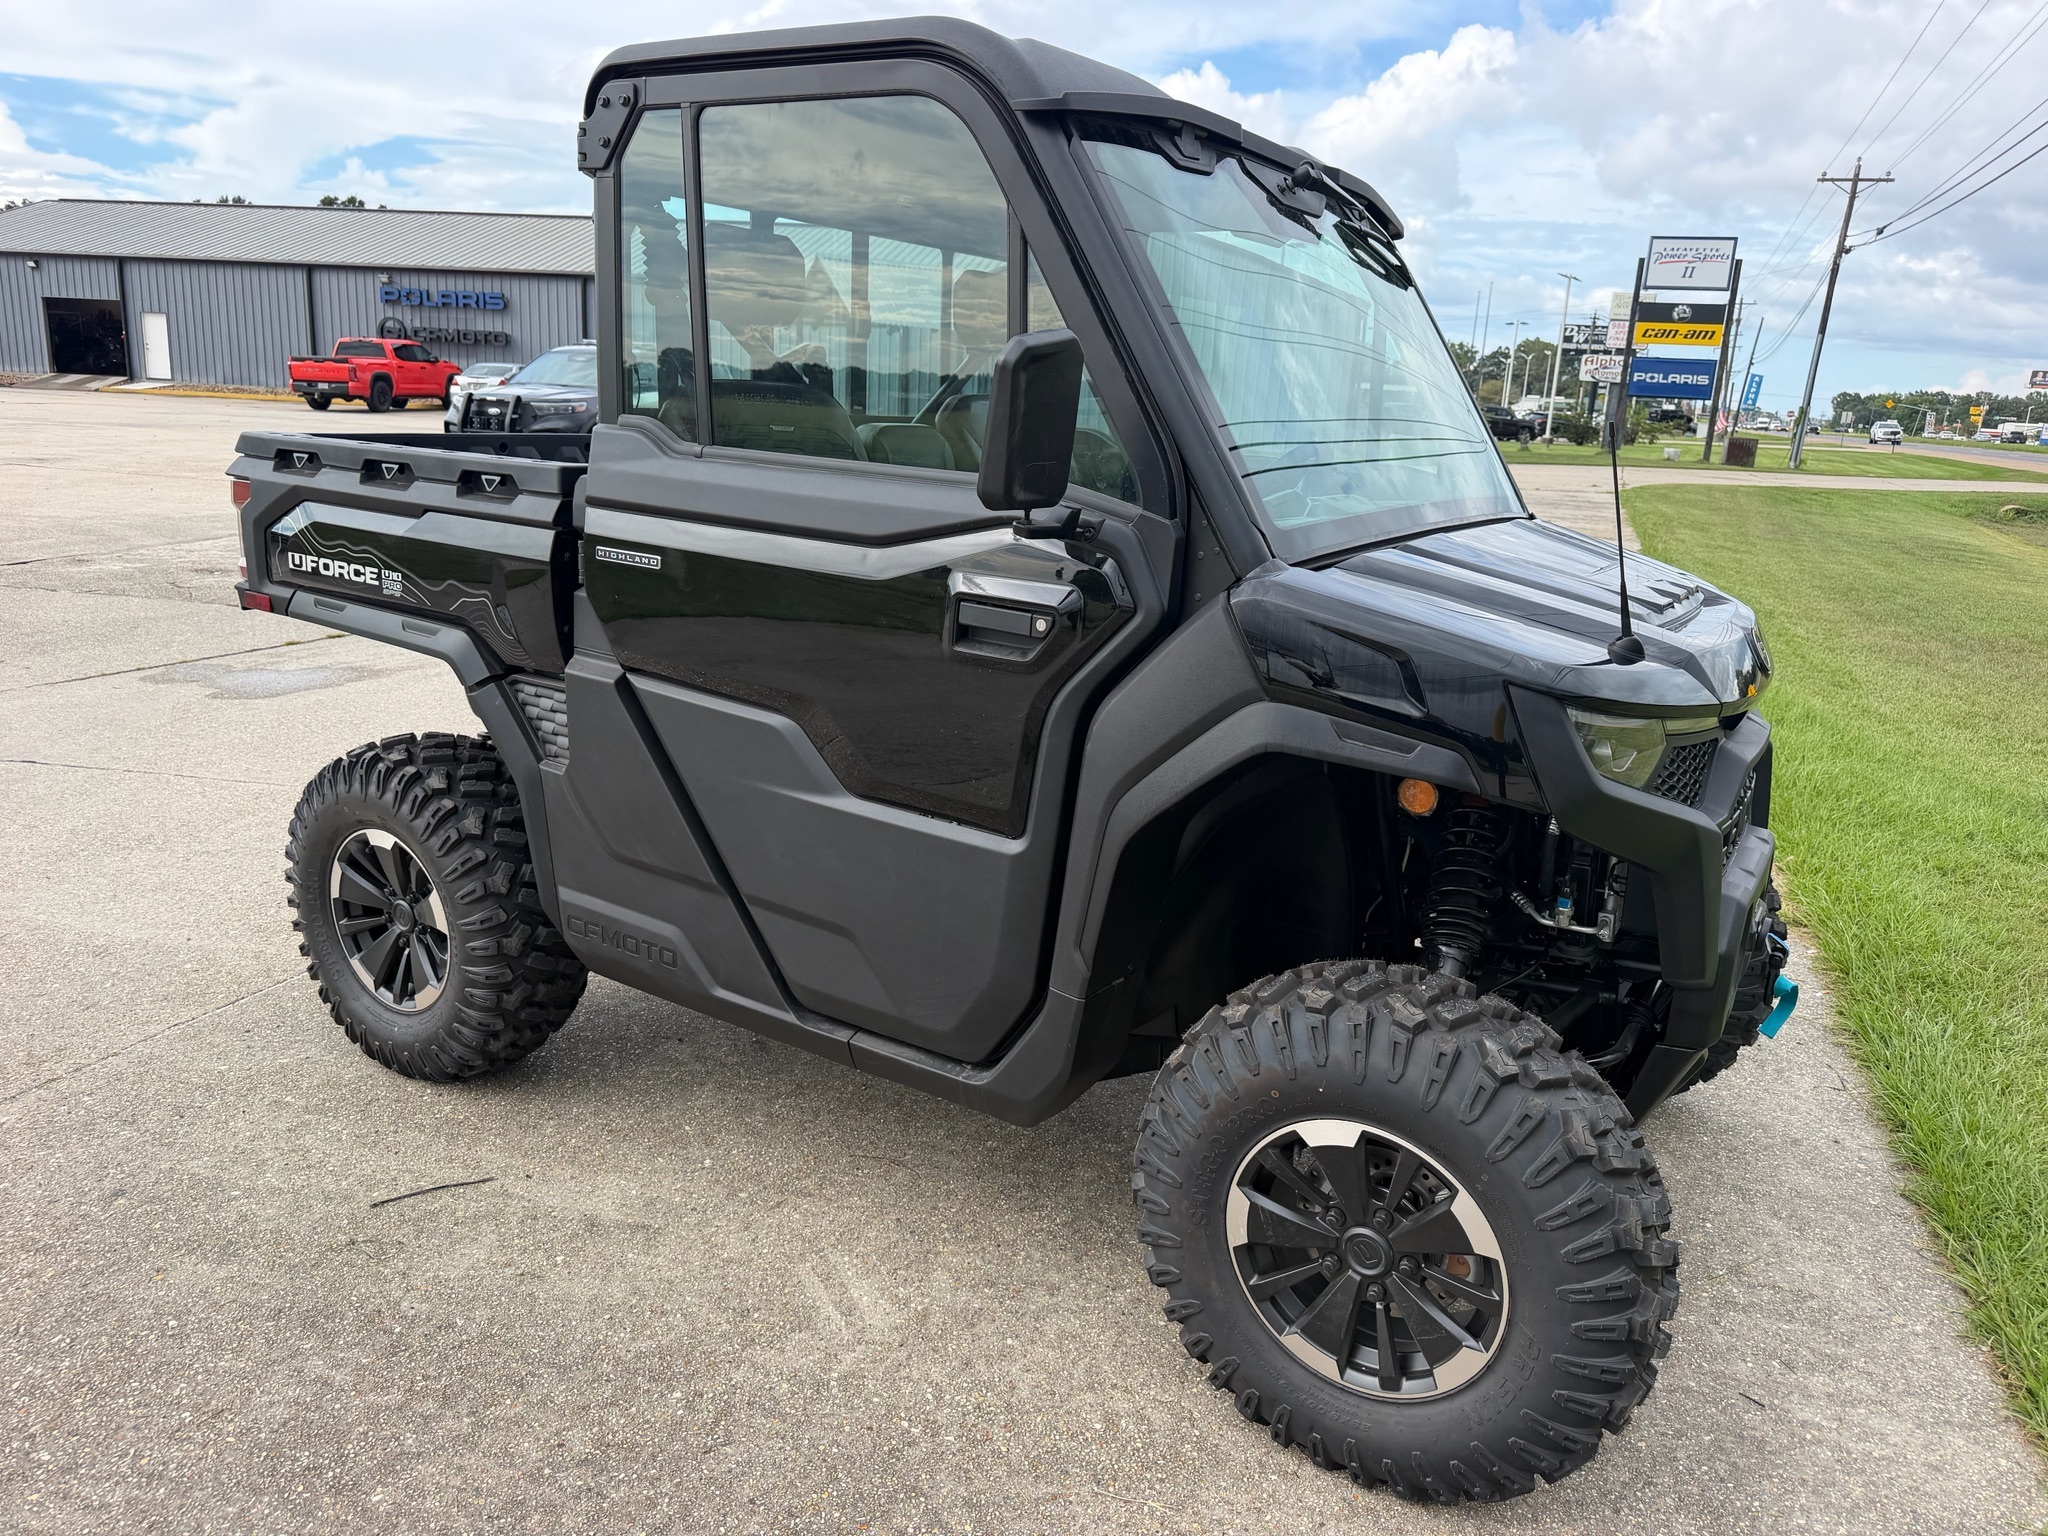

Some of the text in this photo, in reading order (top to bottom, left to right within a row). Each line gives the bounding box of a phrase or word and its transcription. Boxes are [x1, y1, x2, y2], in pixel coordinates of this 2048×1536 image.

[1653, 252, 1730, 264] Power Sports
[1681, 266, 1696, 278] II
[380, 287, 505, 310] POLARIS
[411, 327, 508, 347] CFMOTO
[1641, 328, 1716, 341] can-am
[1633, 372, 1710, 386] POLARIS
[1747, 376, 1760, 406] ALPHA
[598, 550, 657, 565] HIGHLAND
[382, 579, 403, 591] PRO
[567, 914, 678, 970] CFMOTO
[1220, 1096, 1278, 1140] PRO
